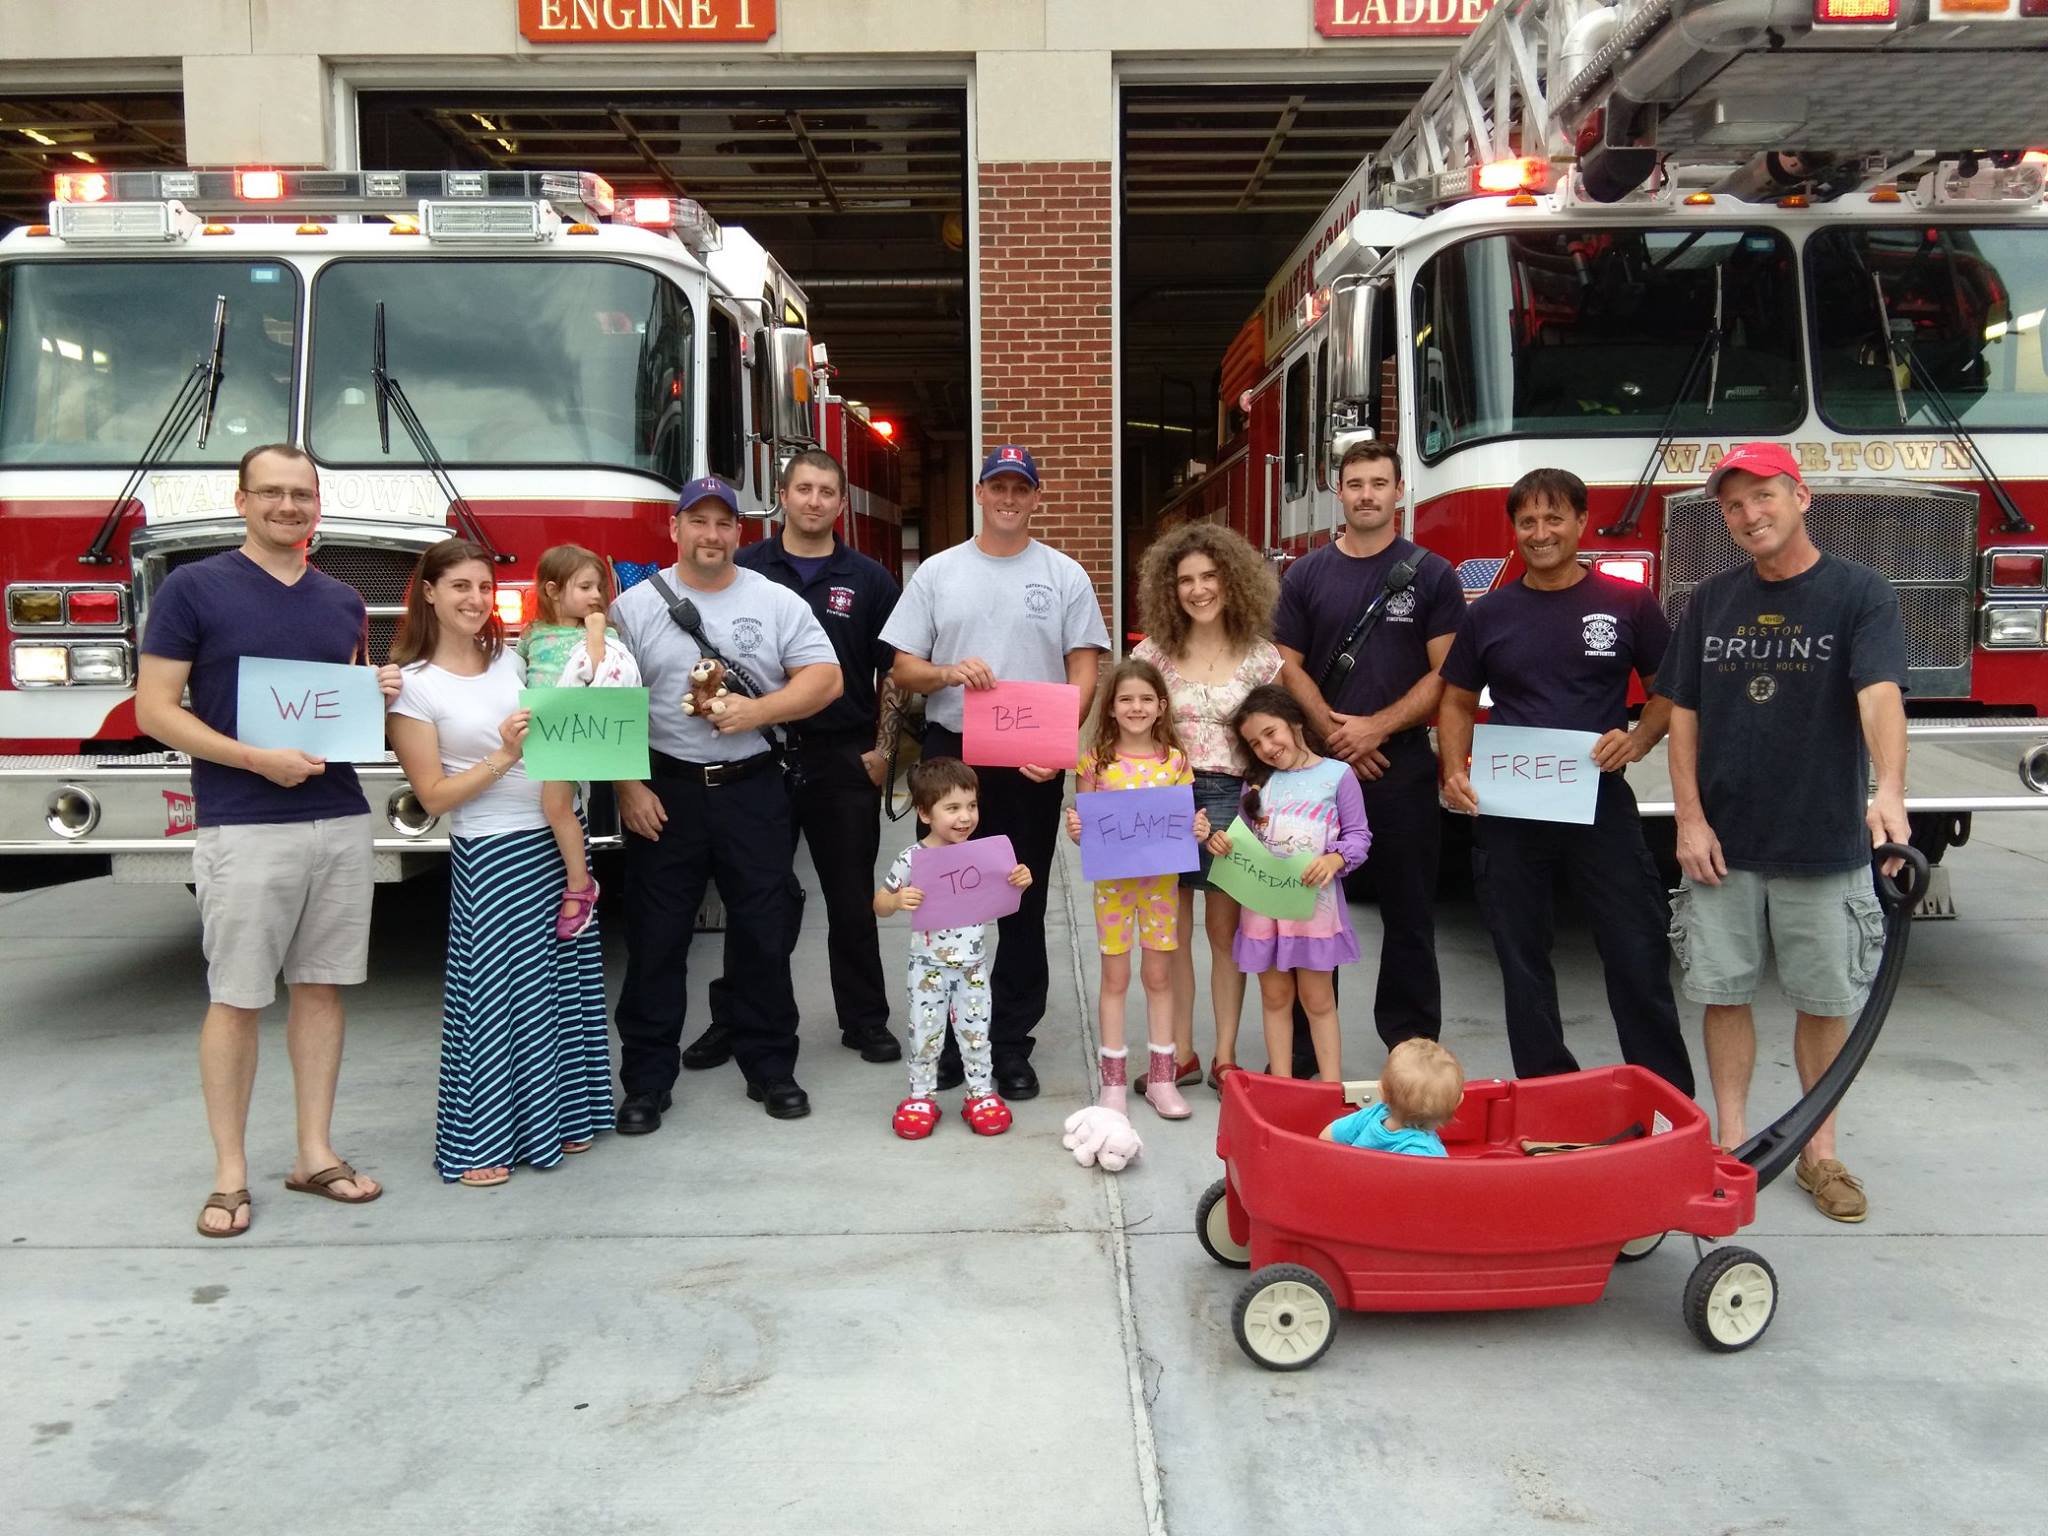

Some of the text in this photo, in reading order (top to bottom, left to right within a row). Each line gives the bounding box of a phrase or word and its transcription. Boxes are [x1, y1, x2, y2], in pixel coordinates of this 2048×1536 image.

[538, 0, 718, 30] ENGINE
[1331, 0, 1502, 25] LADDE
[1657, 440, 1974, 474] WARTOWN
[151, 473, 440, 518] WATTOWN
[1736, 625, 1803, 637] BOSTON
[1702, 634, 1835, 663] BRUINS
[1718, 662, 1737, 673] OLD
[270, 685, 342, 721] WE
[991, 705, 1040, 731] BE
[536, 713, 636, 745] WANT
[1491, 754, 1578, 784] FREE
[1097, 812, 1188, 846] FLAME
[939, 865, 981, 895] TO
[1224, 851, 1309, 889] ETARDAN
